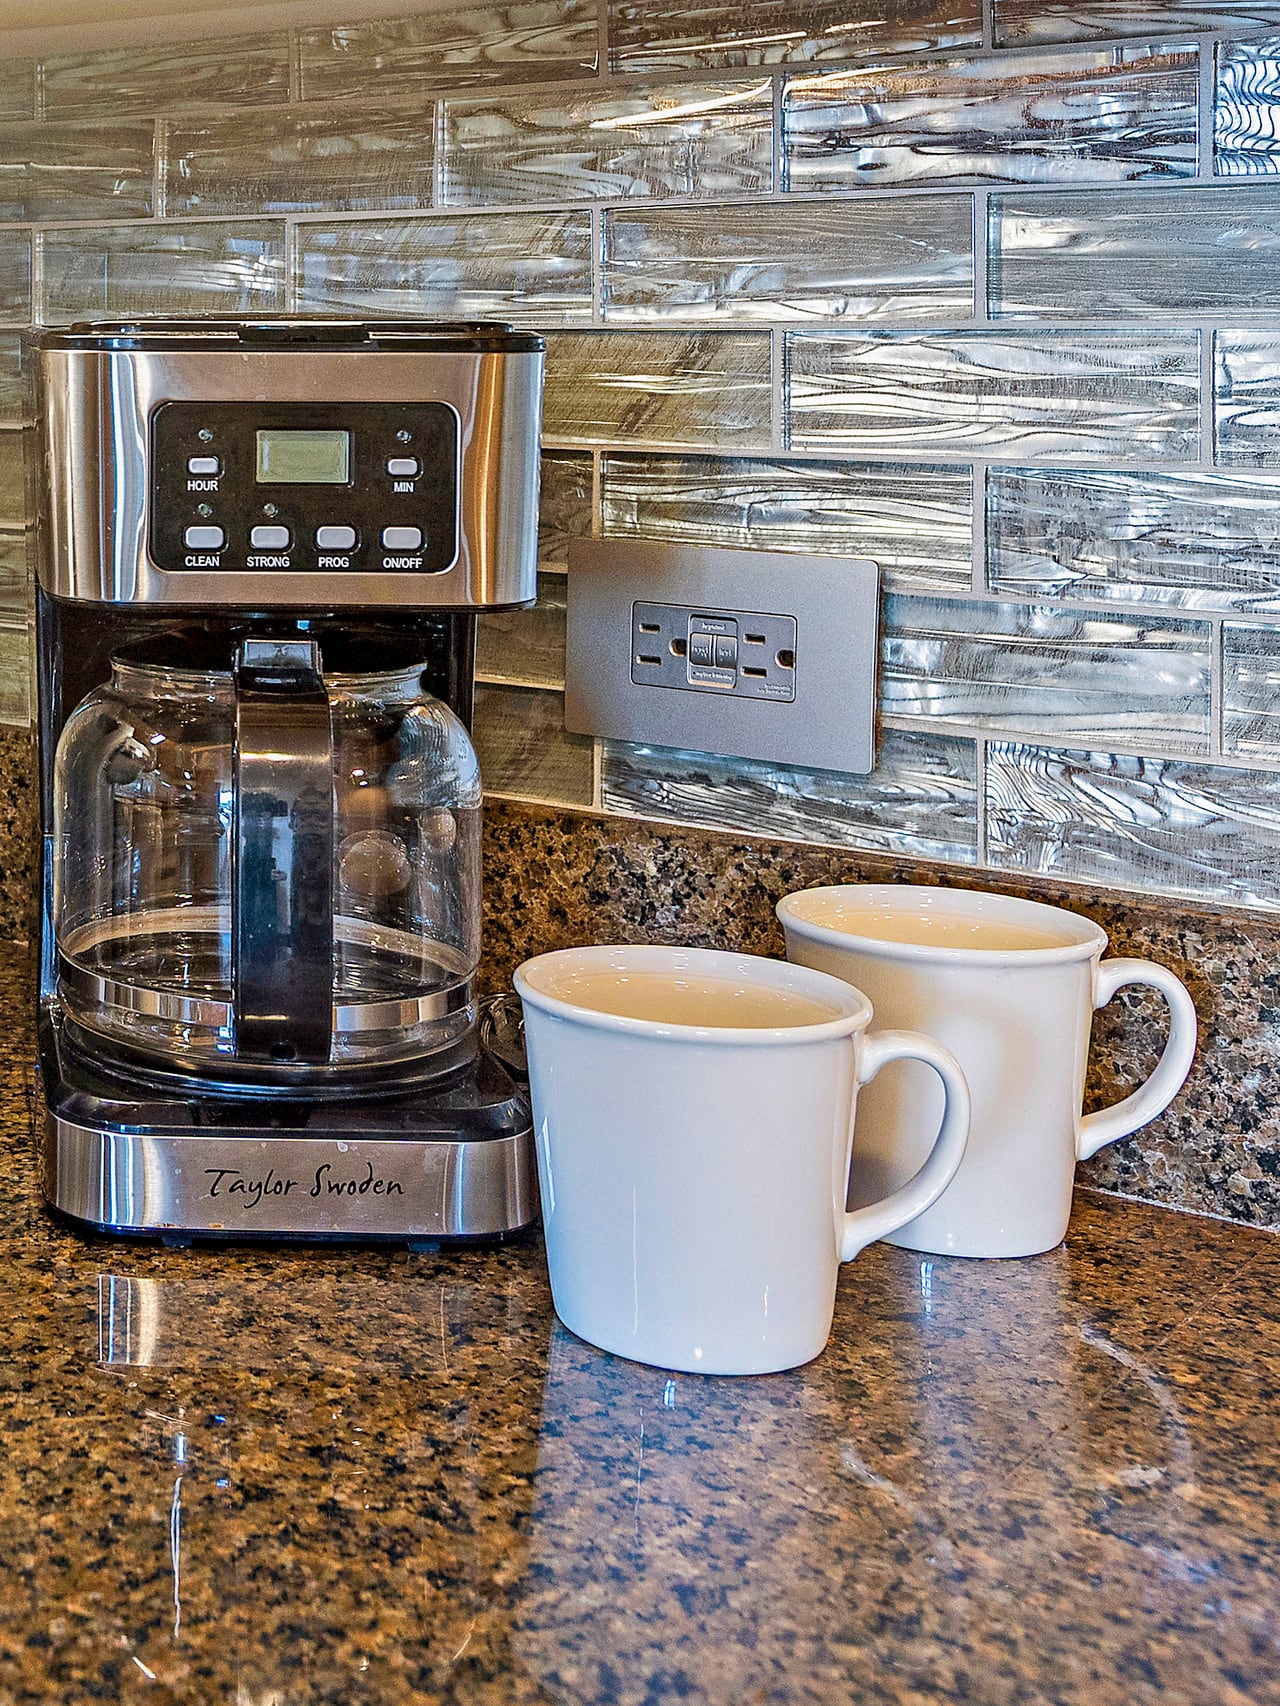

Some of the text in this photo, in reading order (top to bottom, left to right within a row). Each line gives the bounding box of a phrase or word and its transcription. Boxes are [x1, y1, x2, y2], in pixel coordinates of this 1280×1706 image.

[187, 480, 218, 492] HOUR
[393, 481, 414, 493] MIN
[184, 555, 220, 567] CLEAN
[246, 555, 290, 568] STRONG
[318, 556, 350, 568] PROG
[382, 557, 423, 569] ON/OFF
[204, 1161, 405, 1209] Taylor Swoden
